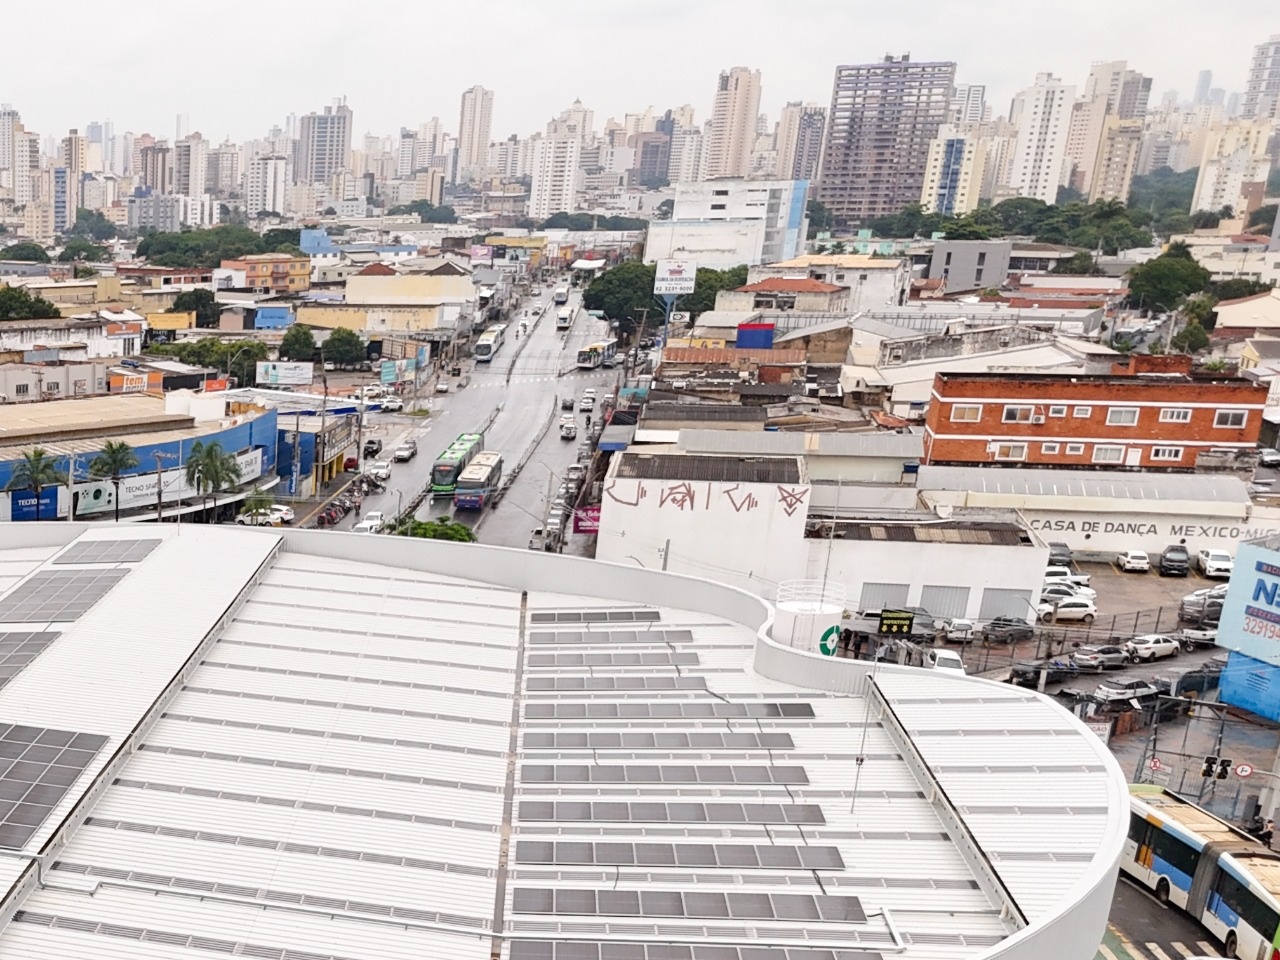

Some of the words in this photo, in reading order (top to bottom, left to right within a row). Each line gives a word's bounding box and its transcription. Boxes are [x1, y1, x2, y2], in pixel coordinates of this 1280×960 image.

[125, 485, 144, 493] TECNO
[18, 498, 37, 506] TECNO
[1030, 519, 1075, 532] CASA
[1081, 521, 1100, 533] DE
[1104, 522, 1158, 537] DANÇA
